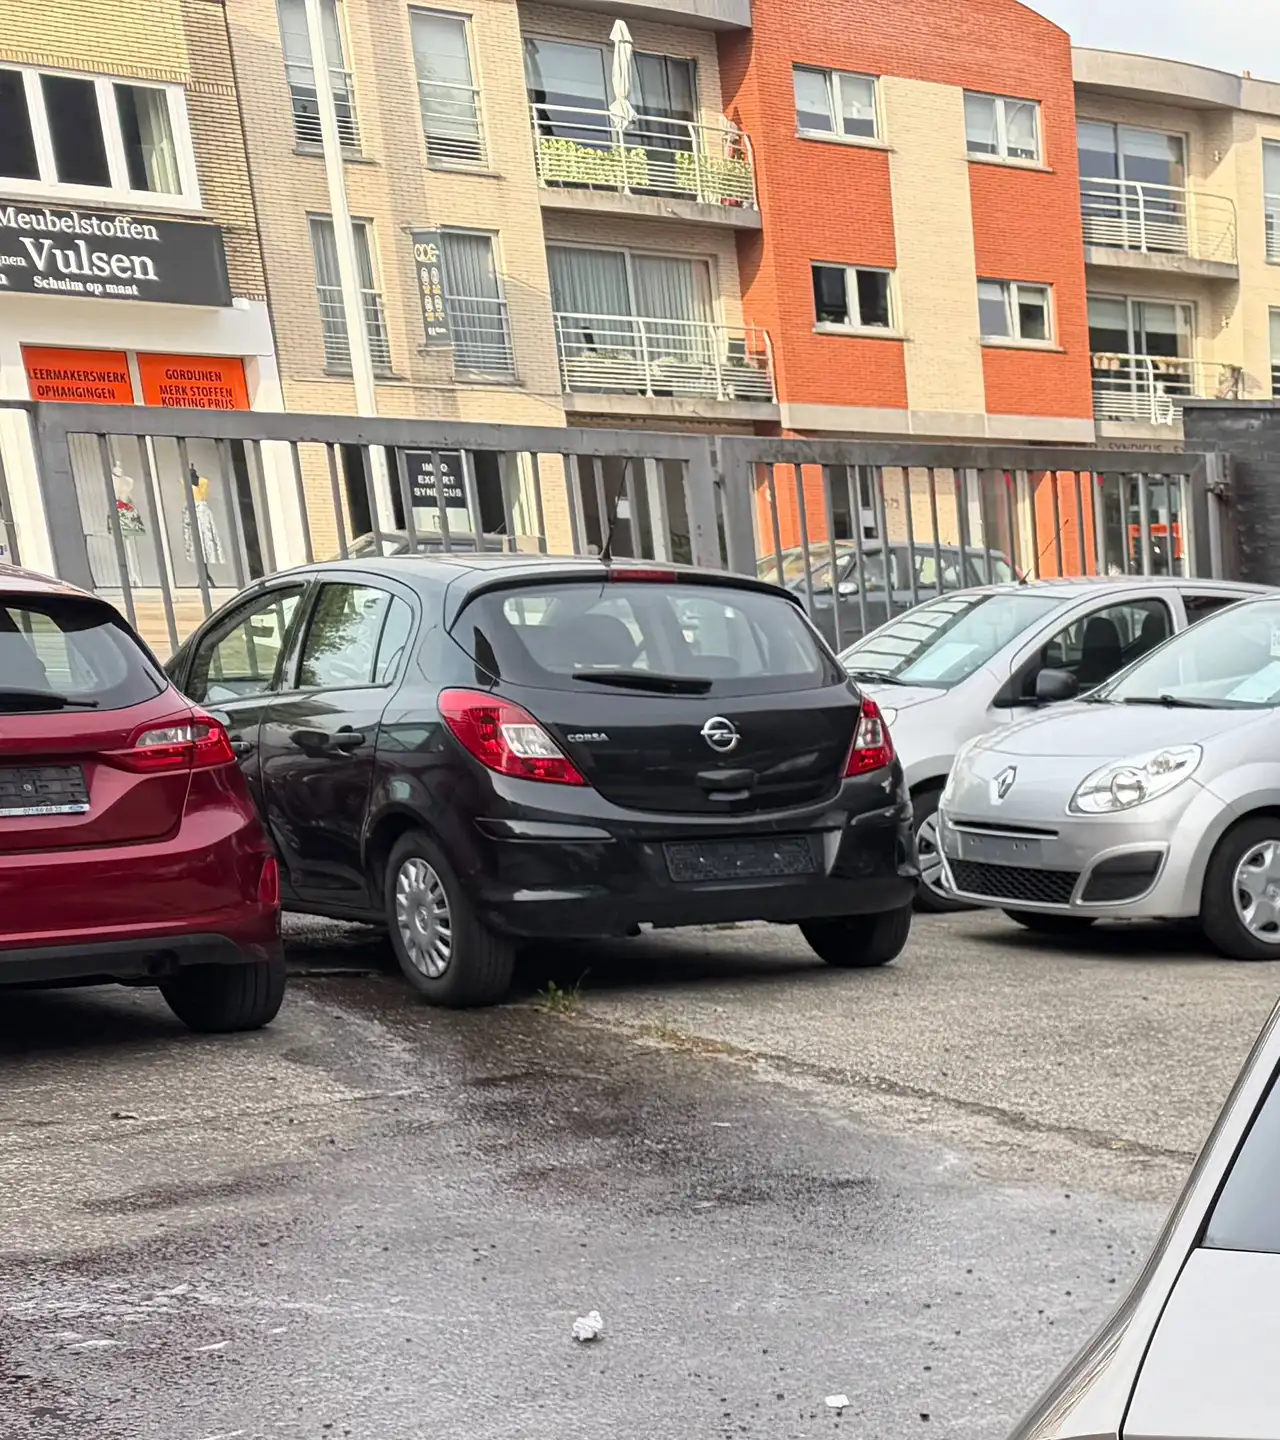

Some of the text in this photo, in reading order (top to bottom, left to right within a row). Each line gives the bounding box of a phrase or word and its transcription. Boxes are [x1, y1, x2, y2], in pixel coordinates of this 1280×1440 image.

[0, 207, 160, 241] Meubelstoffen
[19, 236, 160, 281] Vulsen
[33, 275, 139, 295] Schuim op maat
[37, 385, 116, 399] OPHANGINGEN
[159, 385, 233, 398] MERK STOFFEN
[161, 396, 235, 410] KORTING PRIJS
[422, 463, 448, 472] IMO
[567, 733, 610, 742] CORSA
